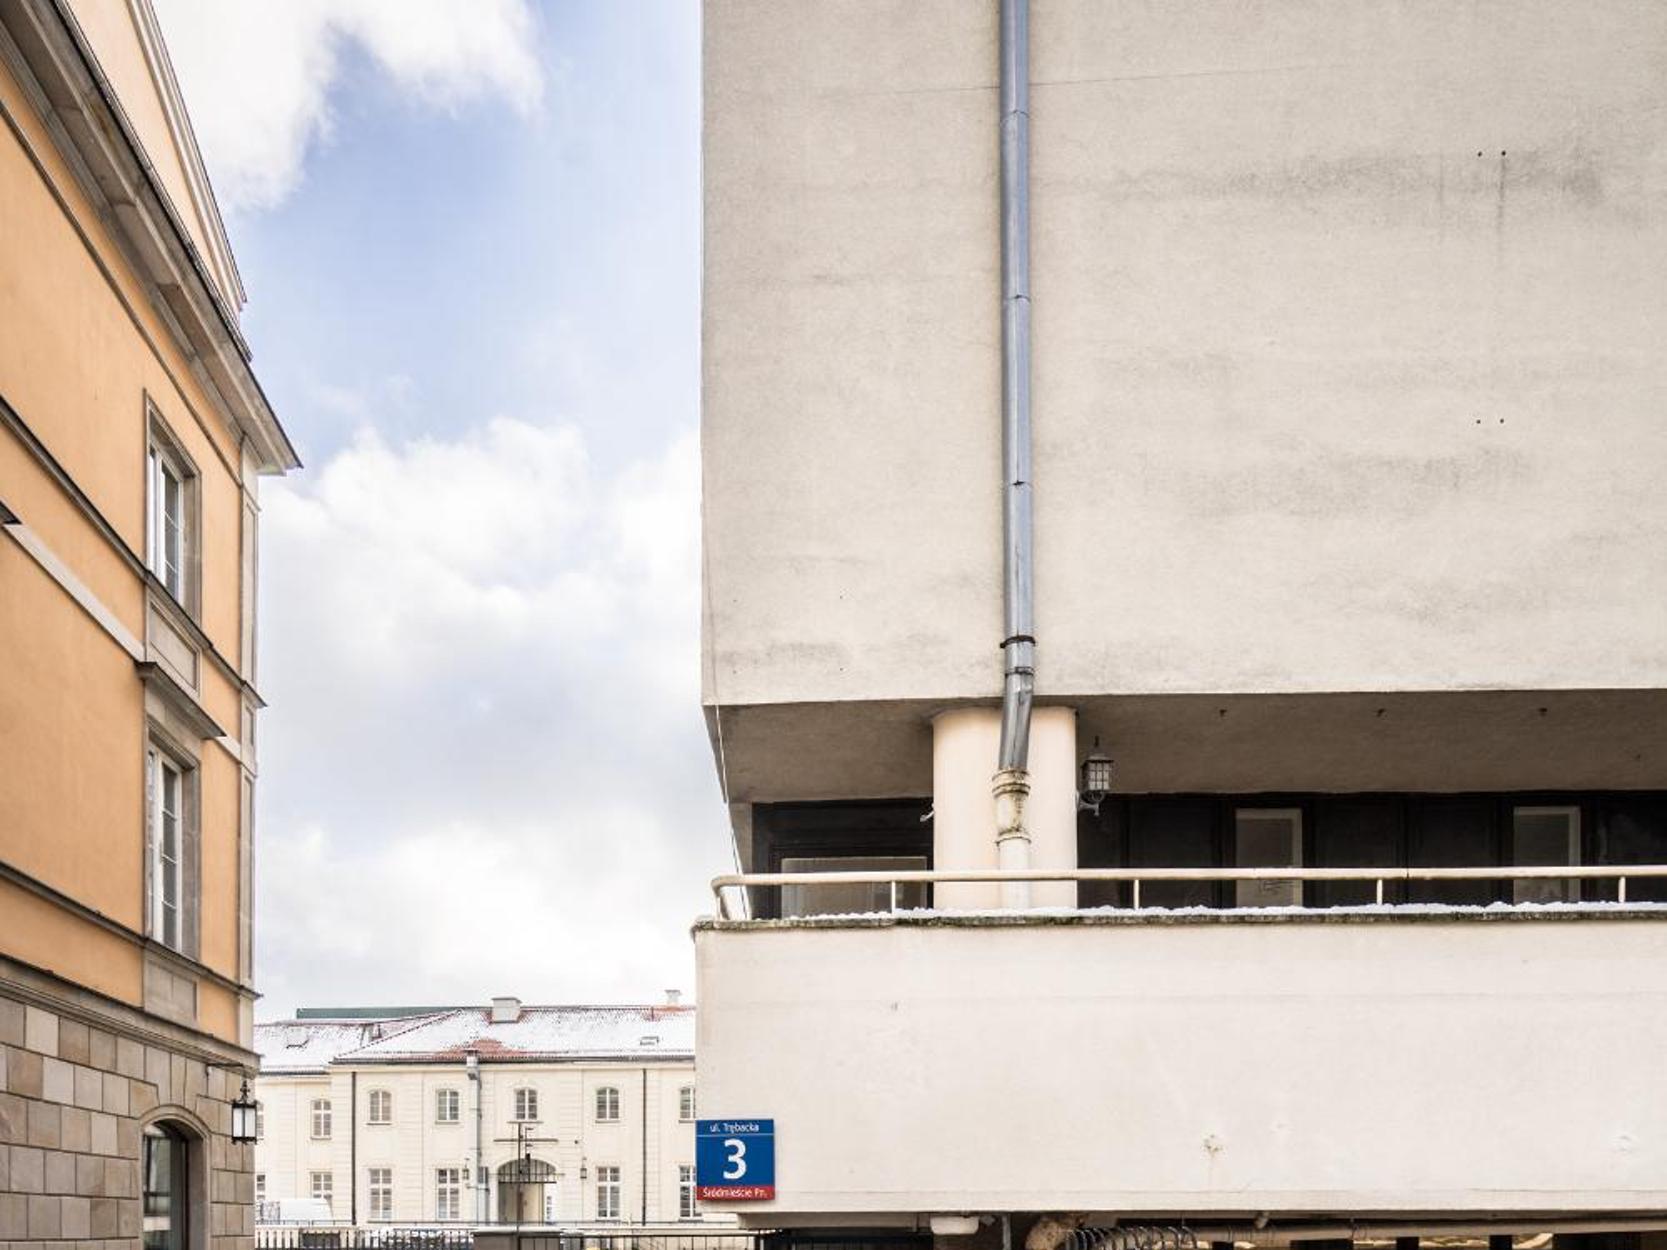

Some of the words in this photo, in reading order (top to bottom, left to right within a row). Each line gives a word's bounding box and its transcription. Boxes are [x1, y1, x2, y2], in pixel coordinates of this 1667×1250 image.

[709, 1123, 720, 1132] ul.
[723, 1122, 760, 1134] Trębacka
[722, 1138, 747, 1180] 3
[702, 1186, 752, 1198] Śródmieście
